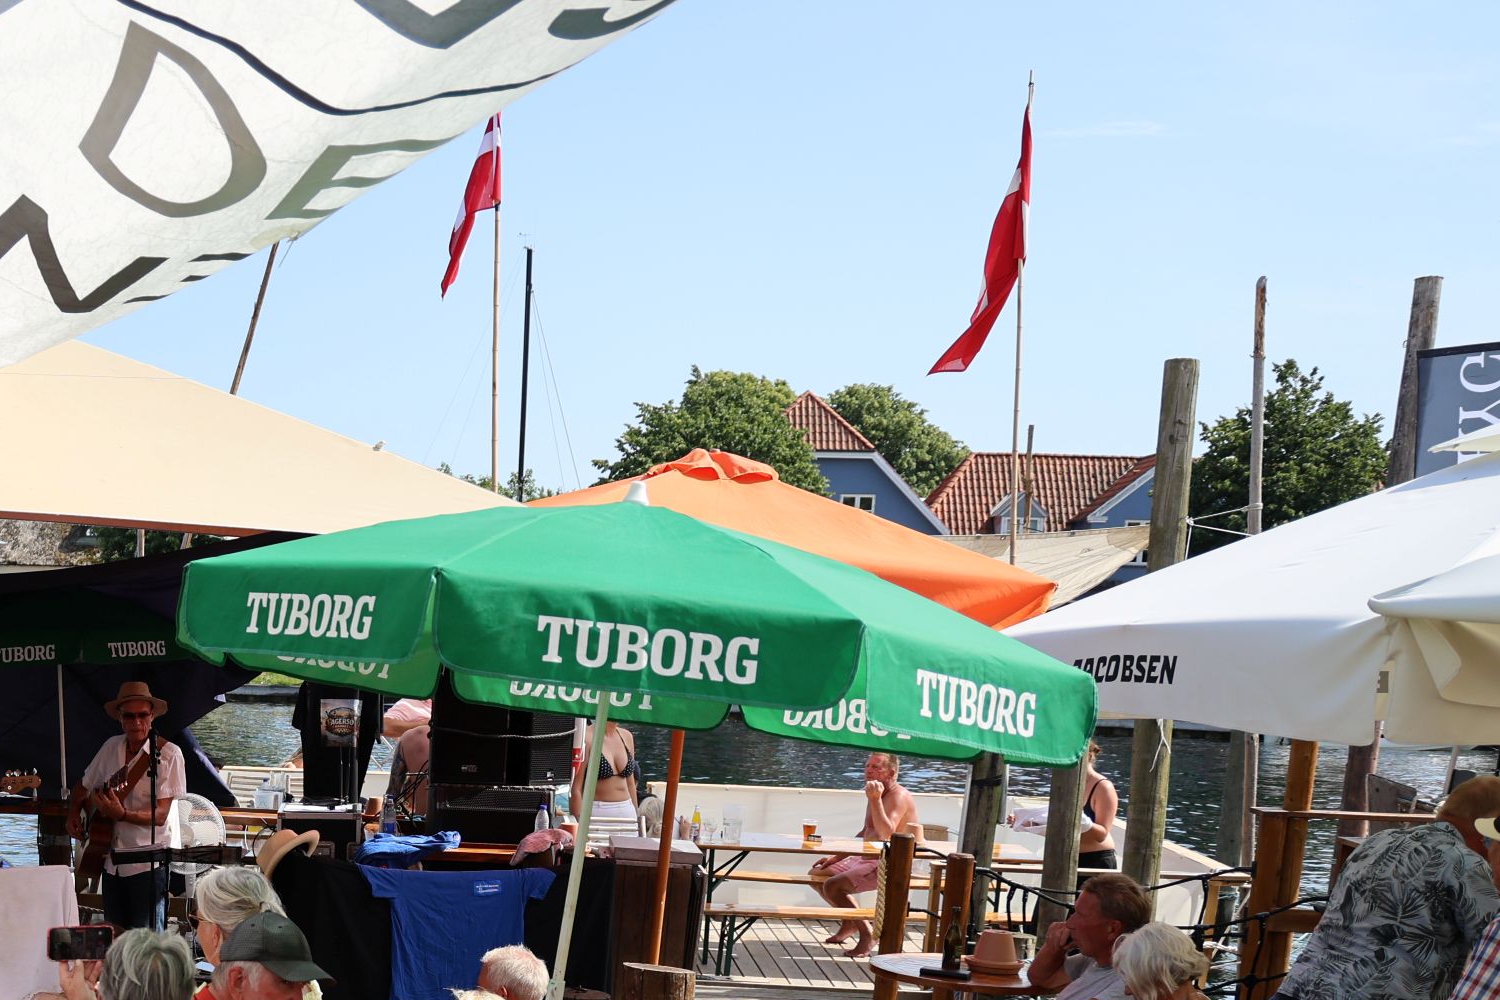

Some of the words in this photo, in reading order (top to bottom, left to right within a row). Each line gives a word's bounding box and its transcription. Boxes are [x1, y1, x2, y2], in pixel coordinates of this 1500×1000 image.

[246, 592, 376, 640] TUBORG
[107, 640, 166, 658] TUBORG
[537, 615, 760, 685] TUBORG
[916, 668, 1037, 738] TUBORG
